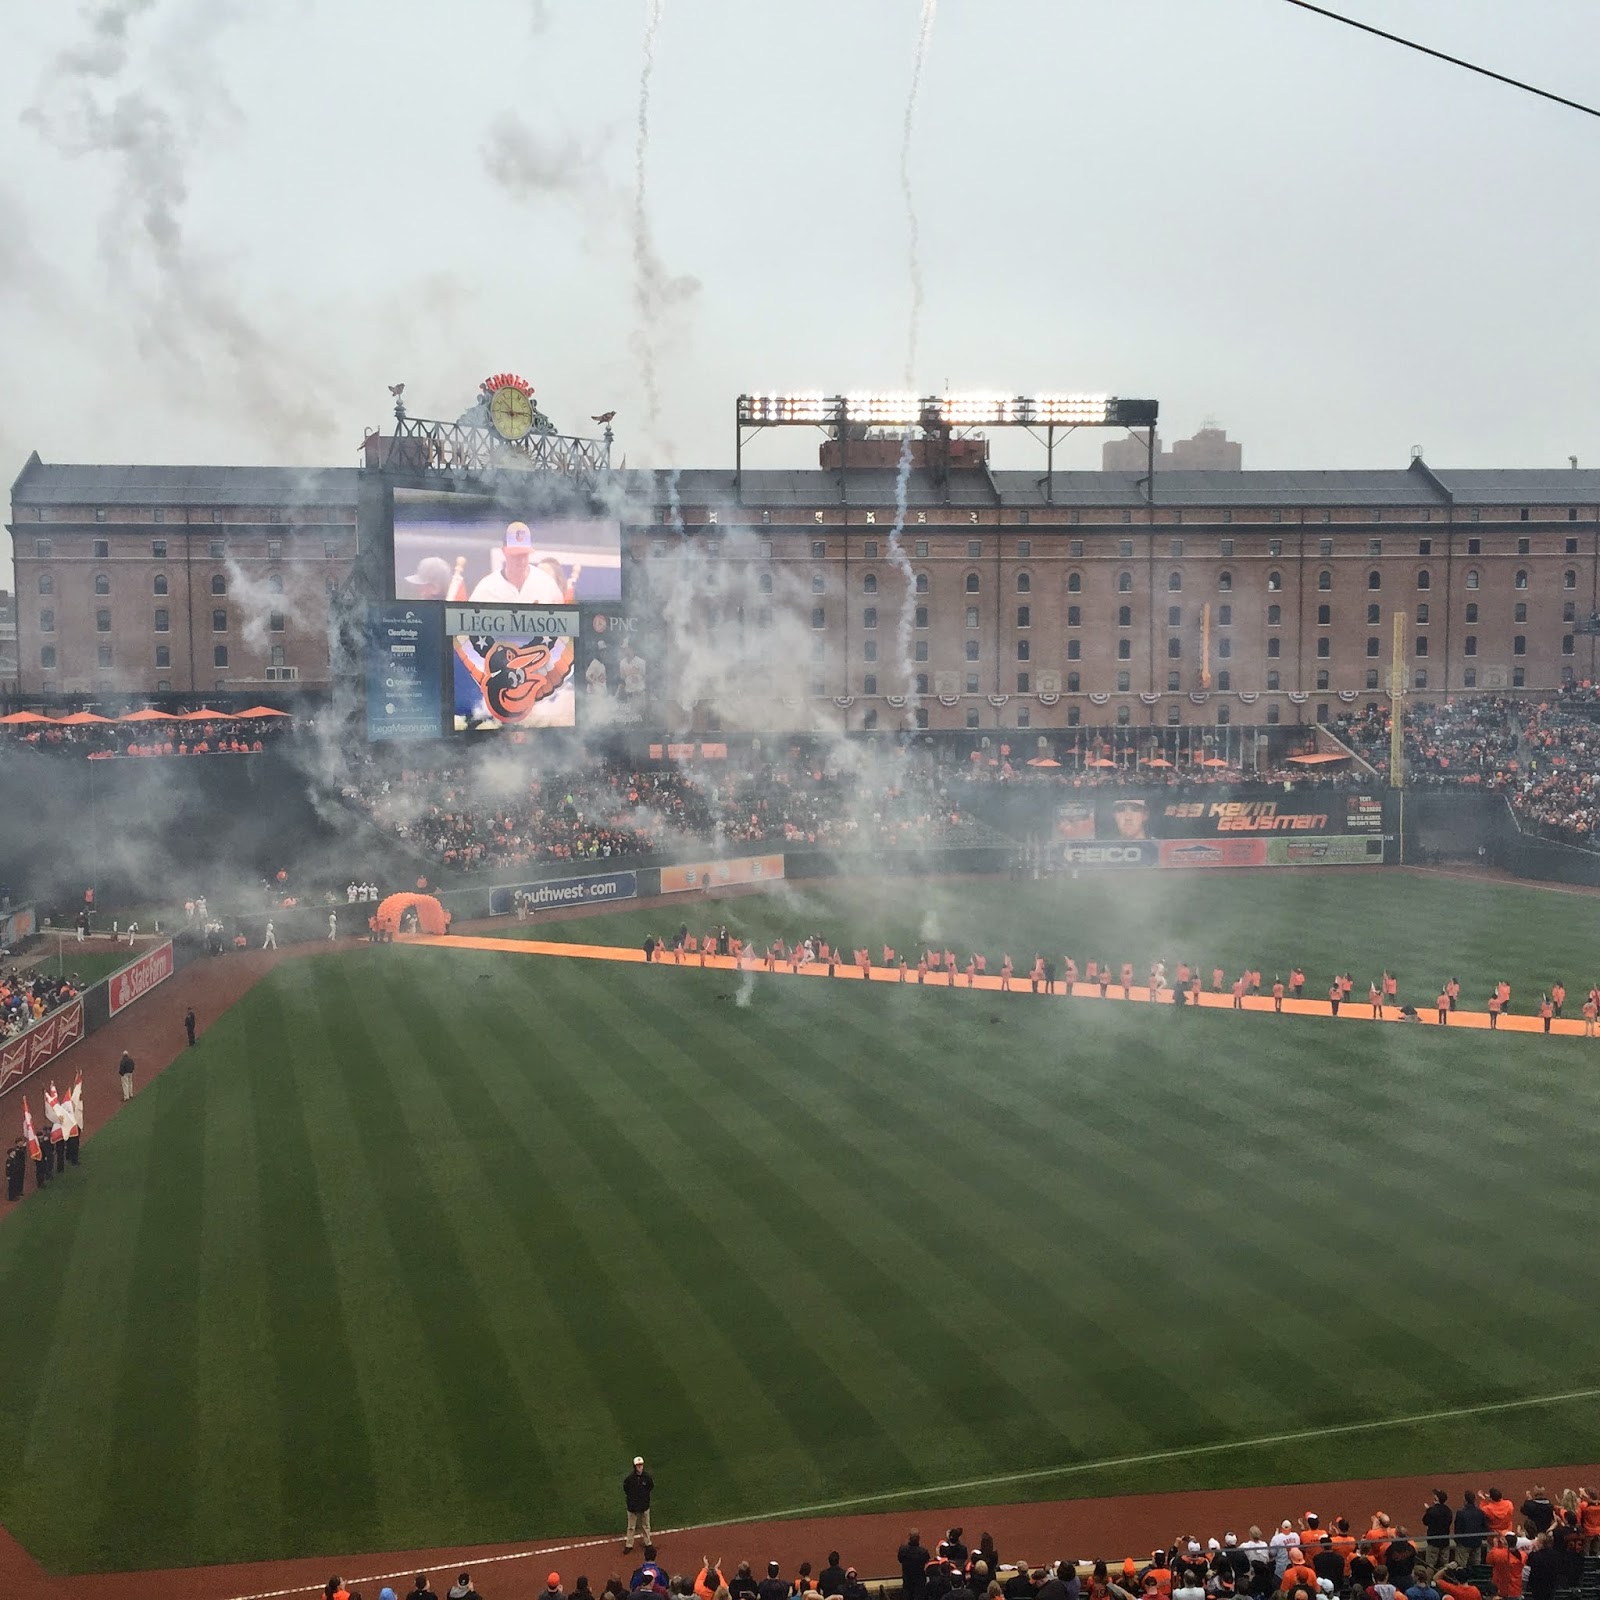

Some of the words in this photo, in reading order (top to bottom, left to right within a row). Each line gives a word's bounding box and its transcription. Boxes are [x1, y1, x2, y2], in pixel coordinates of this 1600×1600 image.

[459, 613, 505, 632] LEGG
[511, 614, 568, 633] MASON
[609, 618, 638, 632] PNC
[1064, 847, 1141, 863] GEICO
